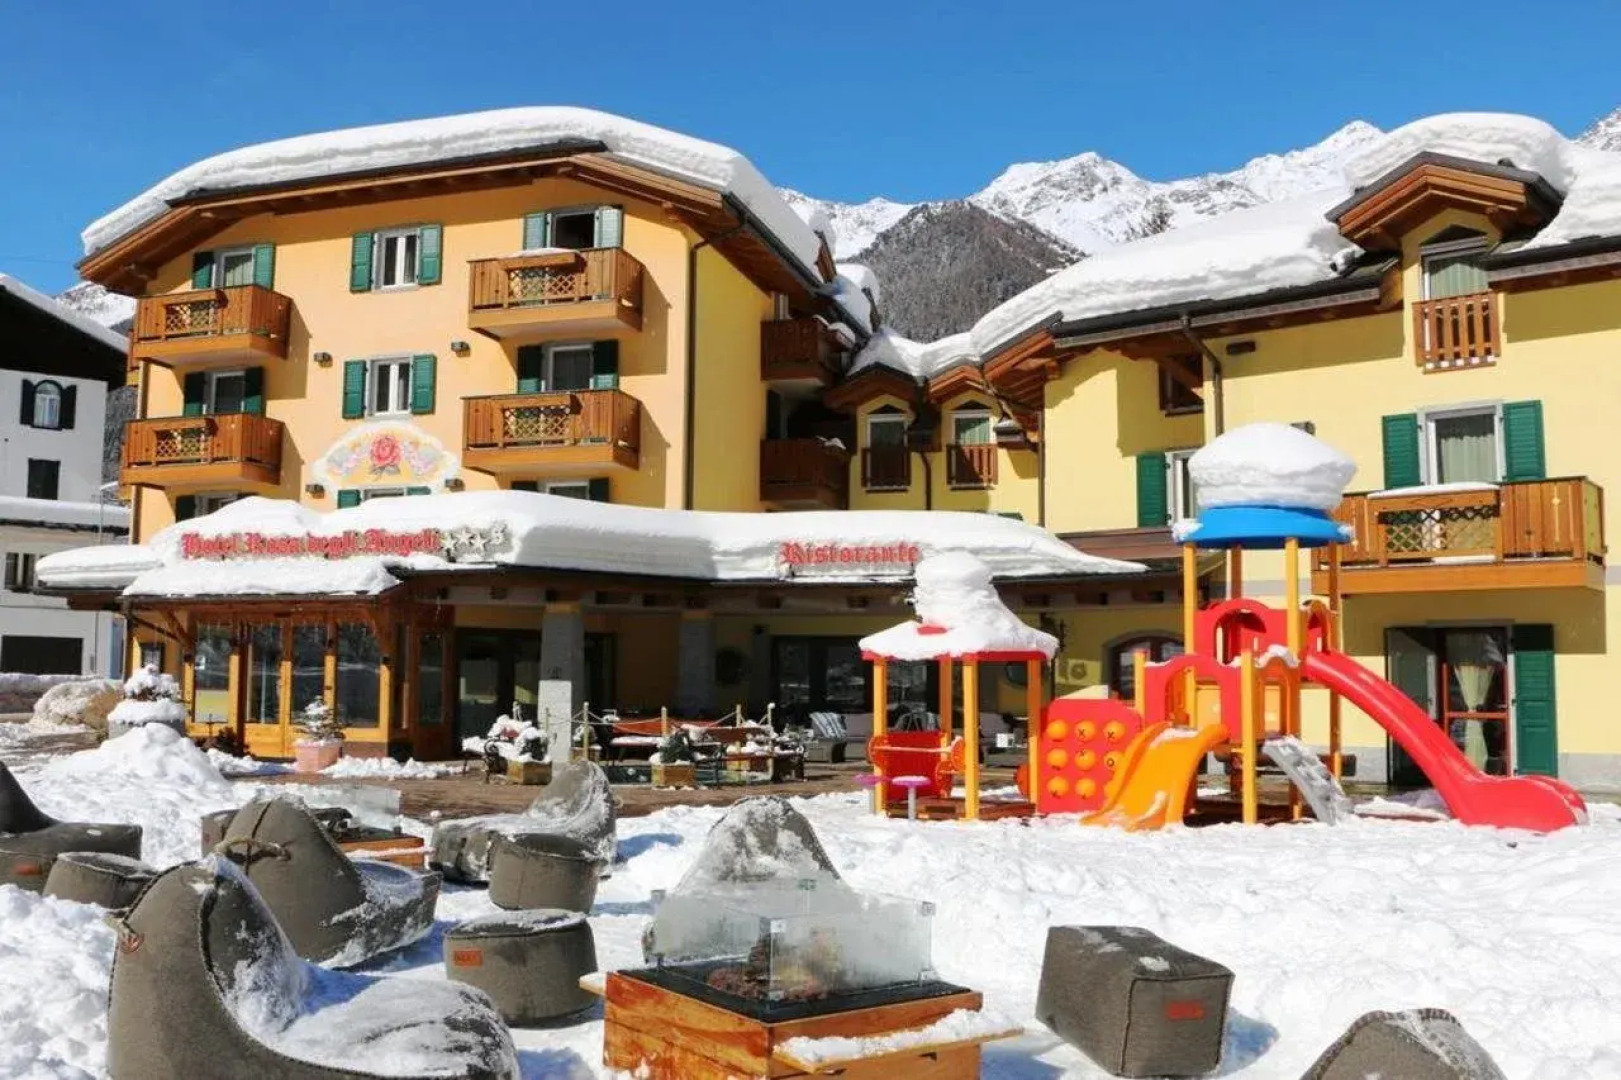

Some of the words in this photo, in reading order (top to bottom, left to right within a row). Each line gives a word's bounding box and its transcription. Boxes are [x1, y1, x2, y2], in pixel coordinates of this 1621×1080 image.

[181, 532, 240, 559] Hotel
[243, 532, 304, 556] Rosa
[364, 528, 442, 557] Angeli
[781, 540, 920, 564] Ristorante
